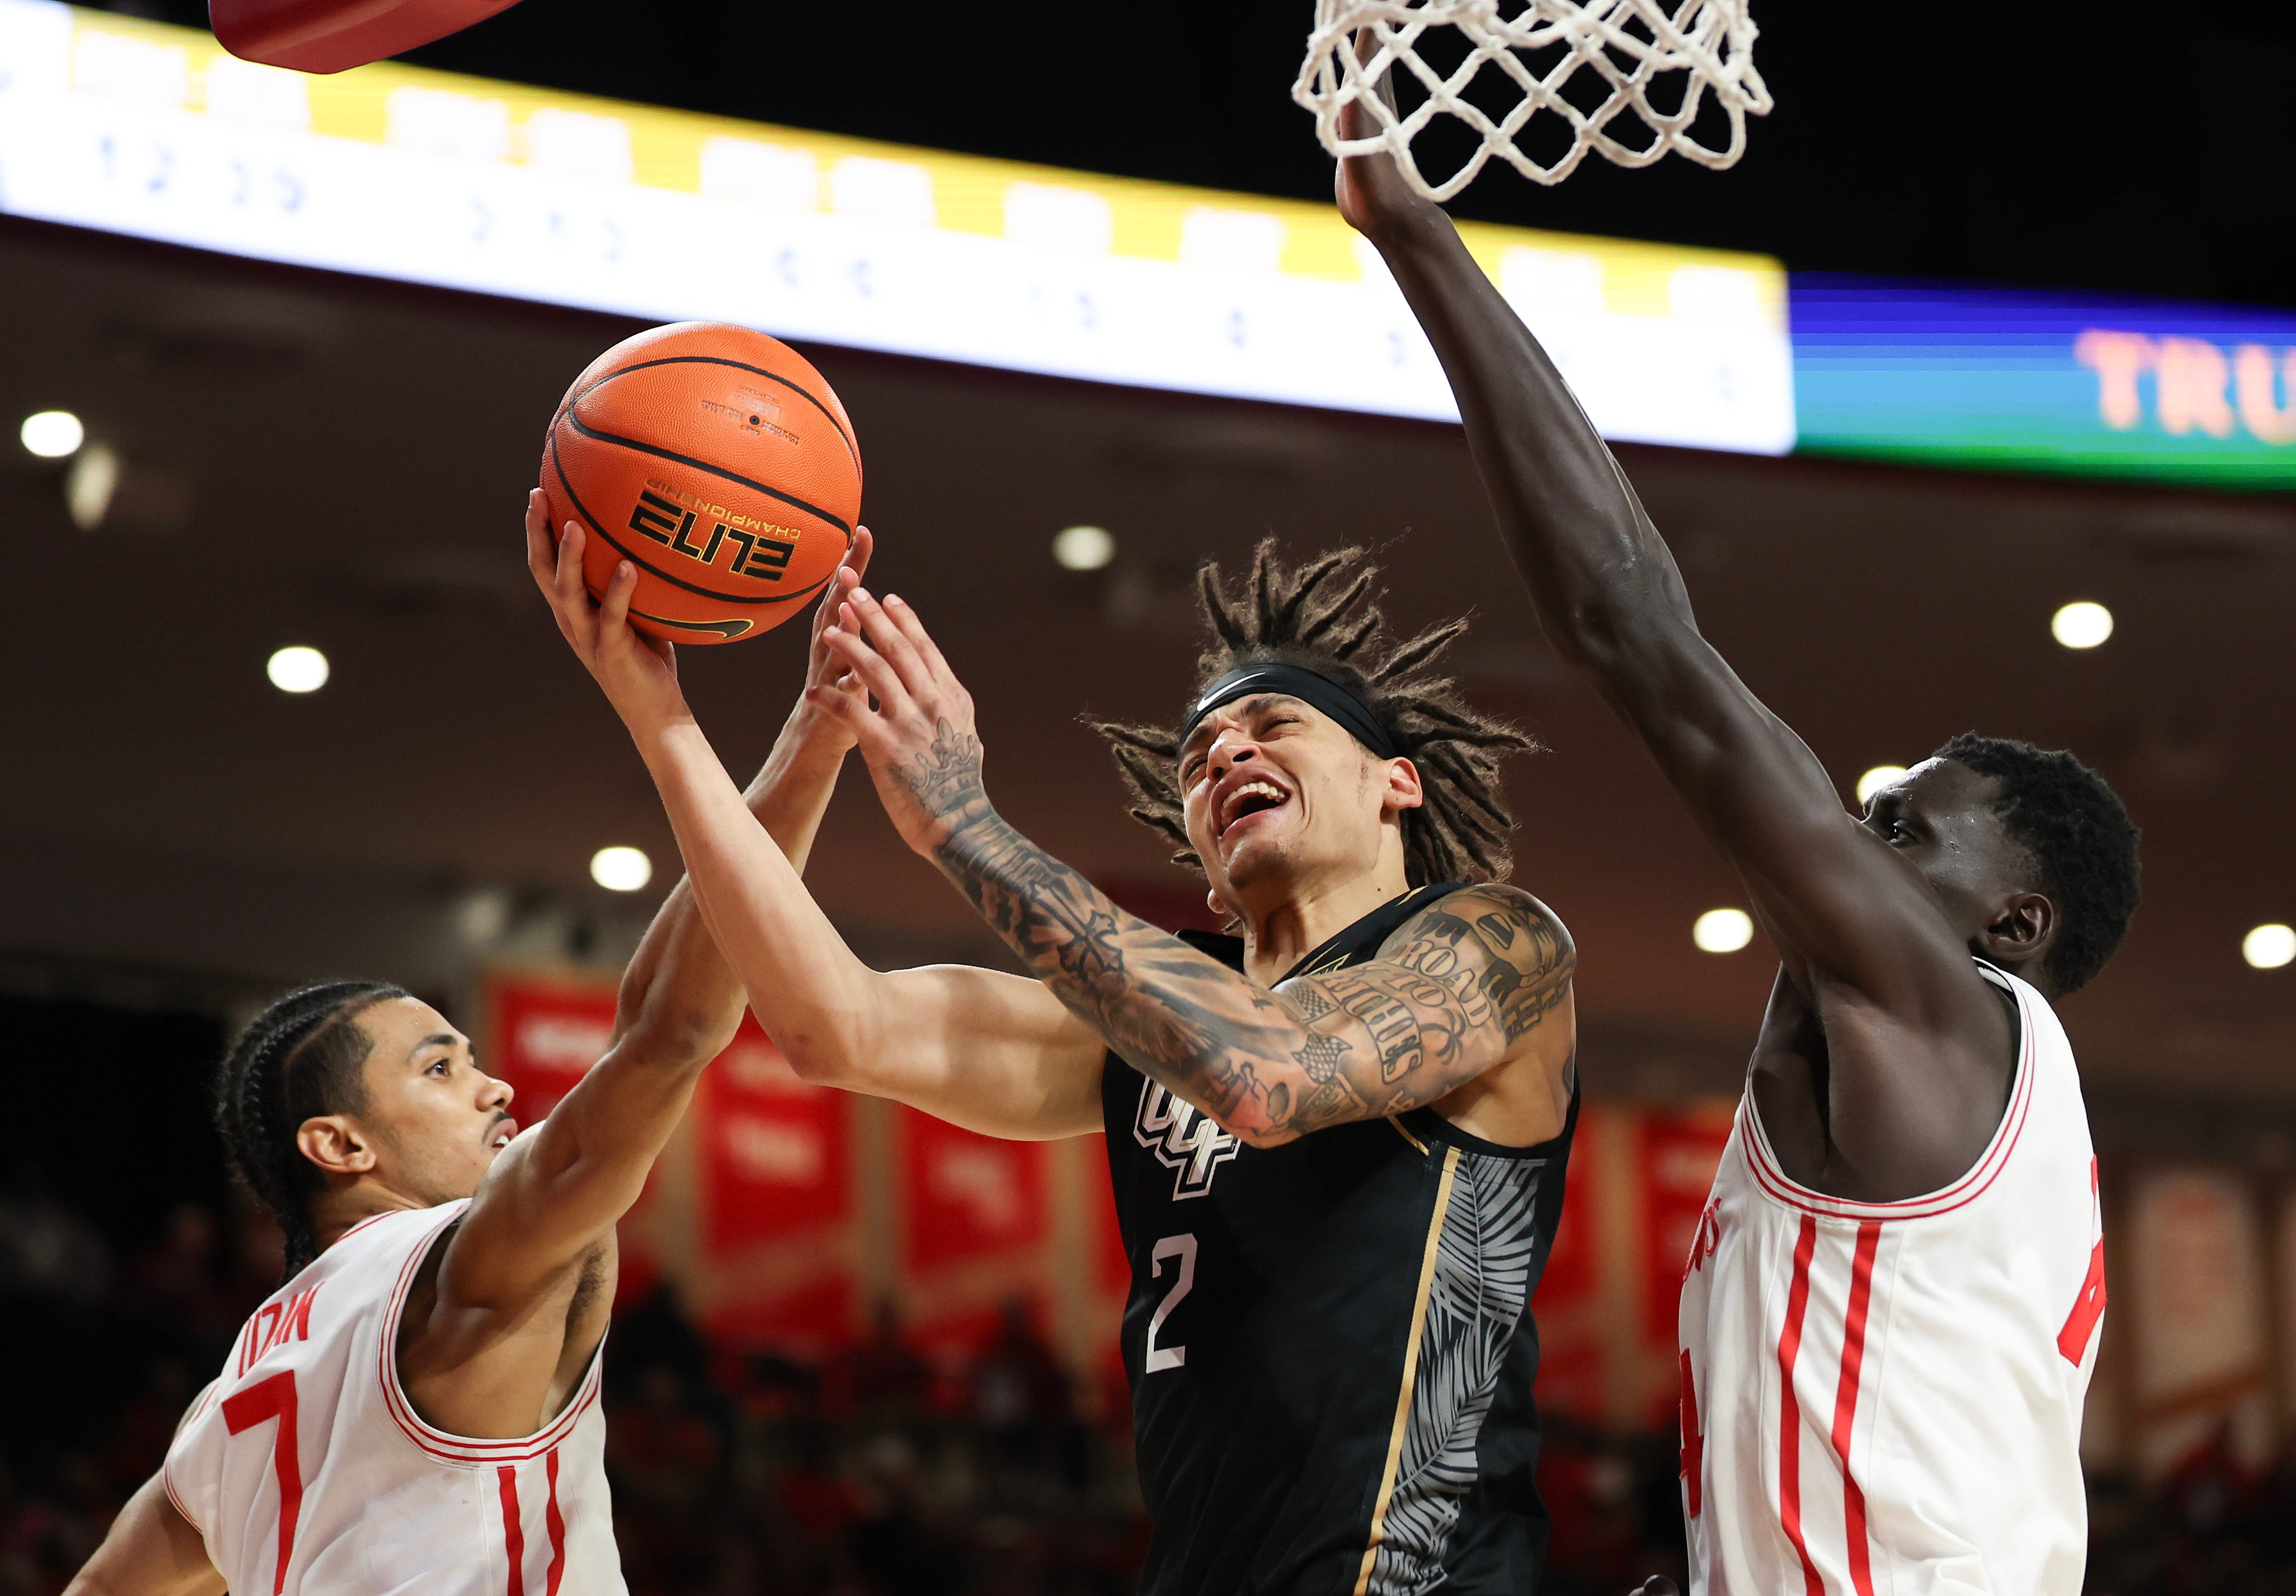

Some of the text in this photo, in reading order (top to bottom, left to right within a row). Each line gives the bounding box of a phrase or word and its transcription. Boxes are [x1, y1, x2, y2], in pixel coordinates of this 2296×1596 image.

[628, 489, 796, 581] ELITE
[646, 478, 802, 539] CHAMPIONSHIP
[1382, 973, 1446, 1007] TO
[1386, 939, 1492, 1028] ROAD
[1146, 1233, 1198, 1374] 2
[221, 1369, 303, 1596] 7
